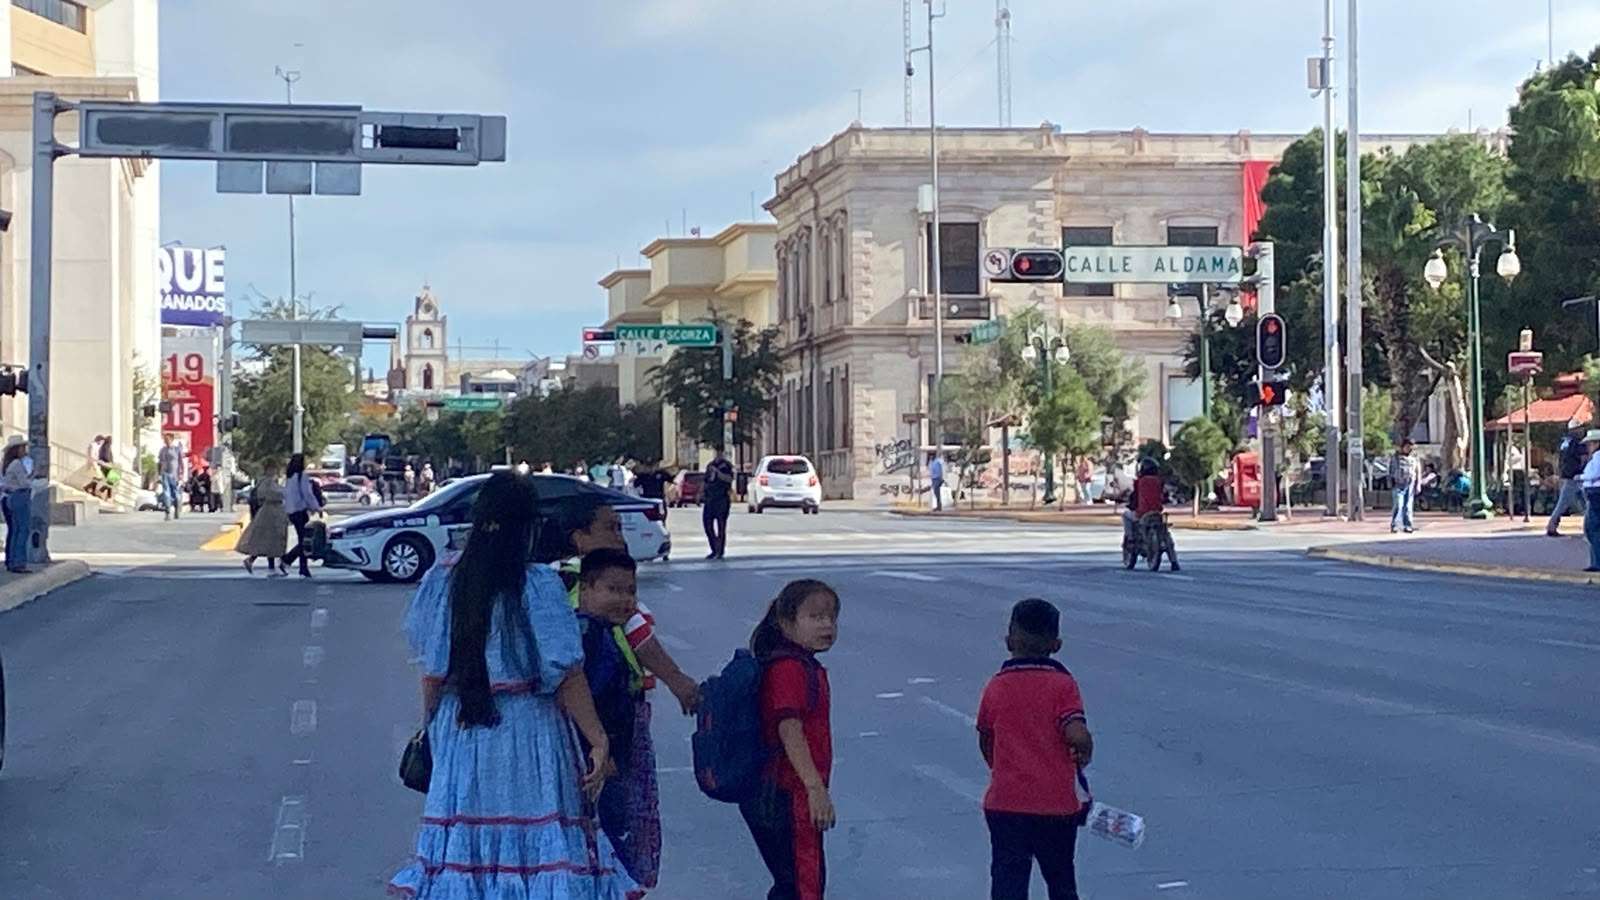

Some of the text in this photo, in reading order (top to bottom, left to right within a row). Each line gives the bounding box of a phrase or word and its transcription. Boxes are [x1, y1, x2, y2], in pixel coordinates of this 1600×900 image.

[1067, 256, 1240, 273] CALLE ALDAMA
[619, 328, 711, 341] CALLE ESCORZA
